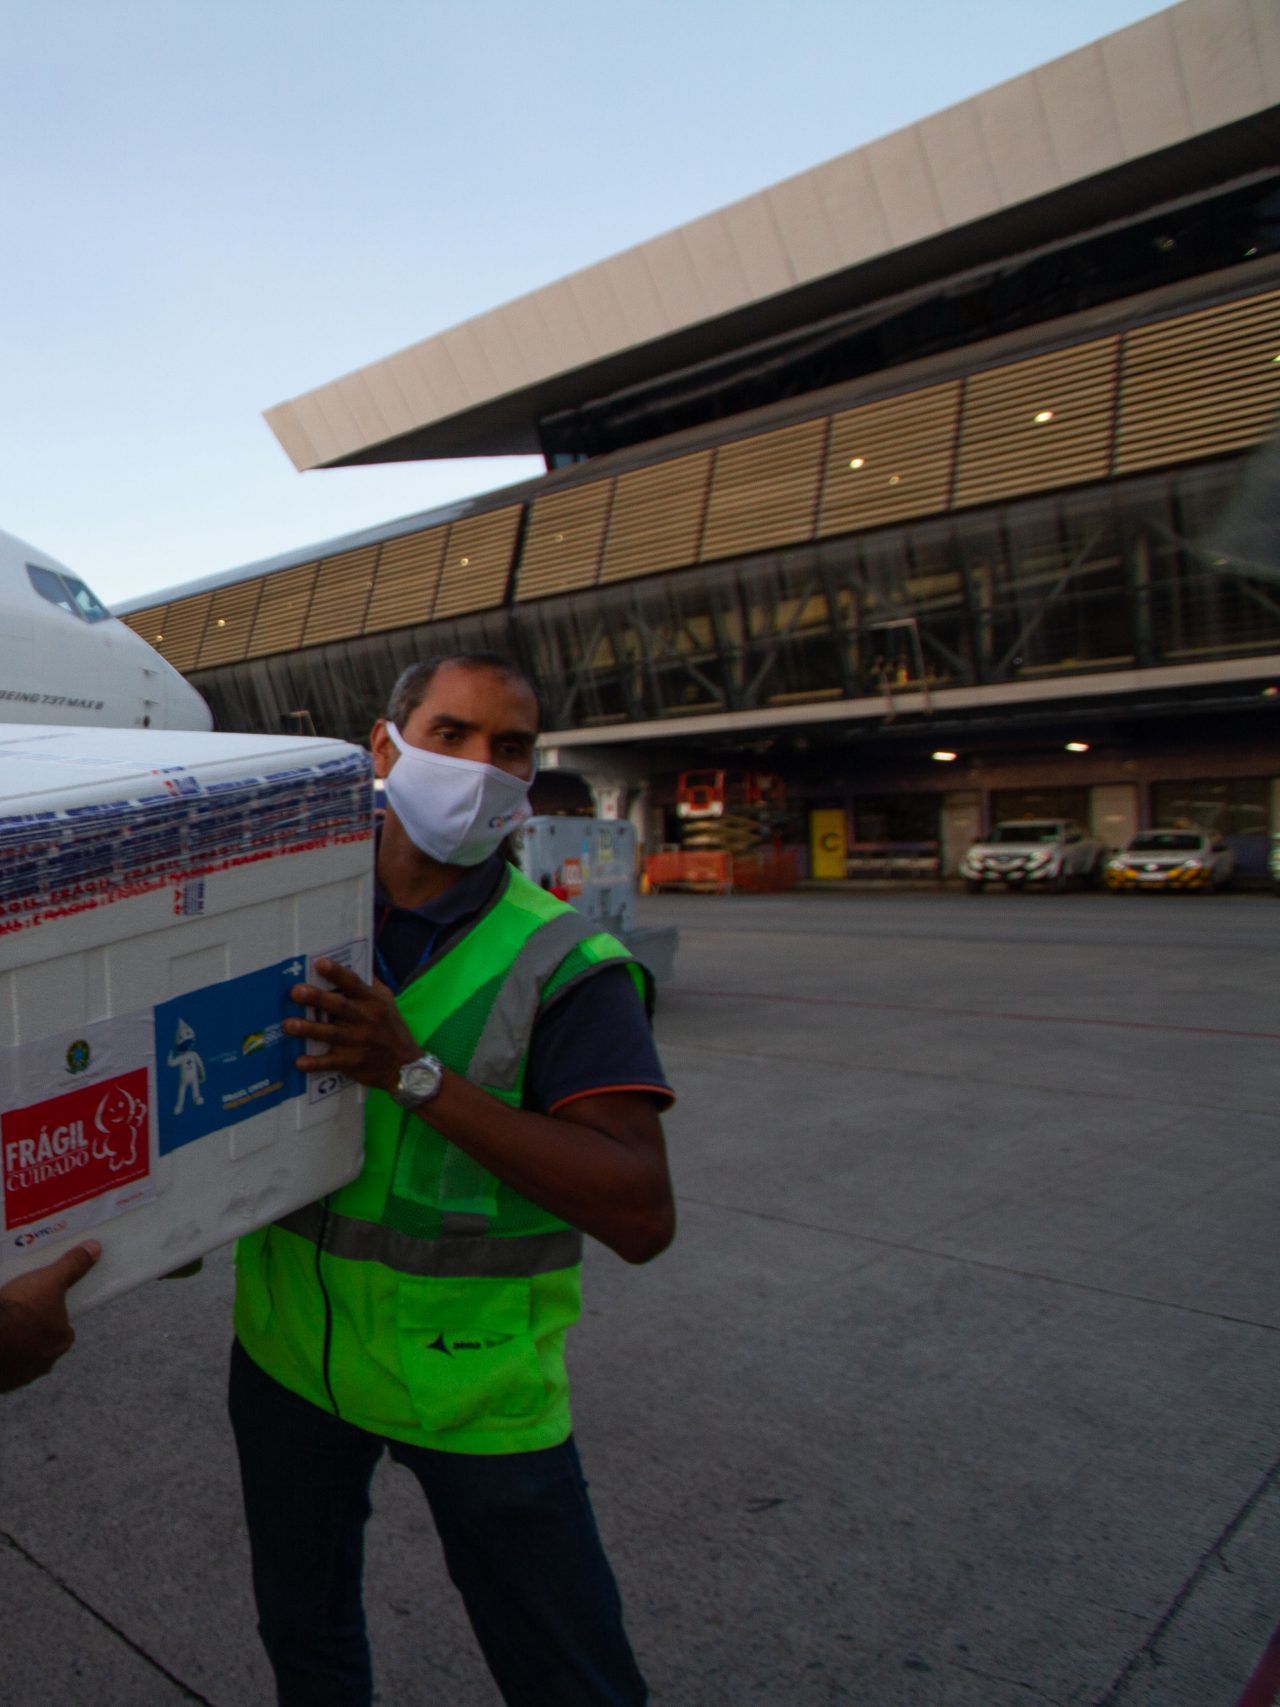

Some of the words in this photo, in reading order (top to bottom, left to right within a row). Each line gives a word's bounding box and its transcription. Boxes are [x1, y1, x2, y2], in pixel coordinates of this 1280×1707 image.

[41, 694, 66, 706] 737
[66, 697, 95, 710] MAX
[5, 1120, 89, 1173] FRÁGIL
[6, 1150, 90, 1192] CUIDADO
